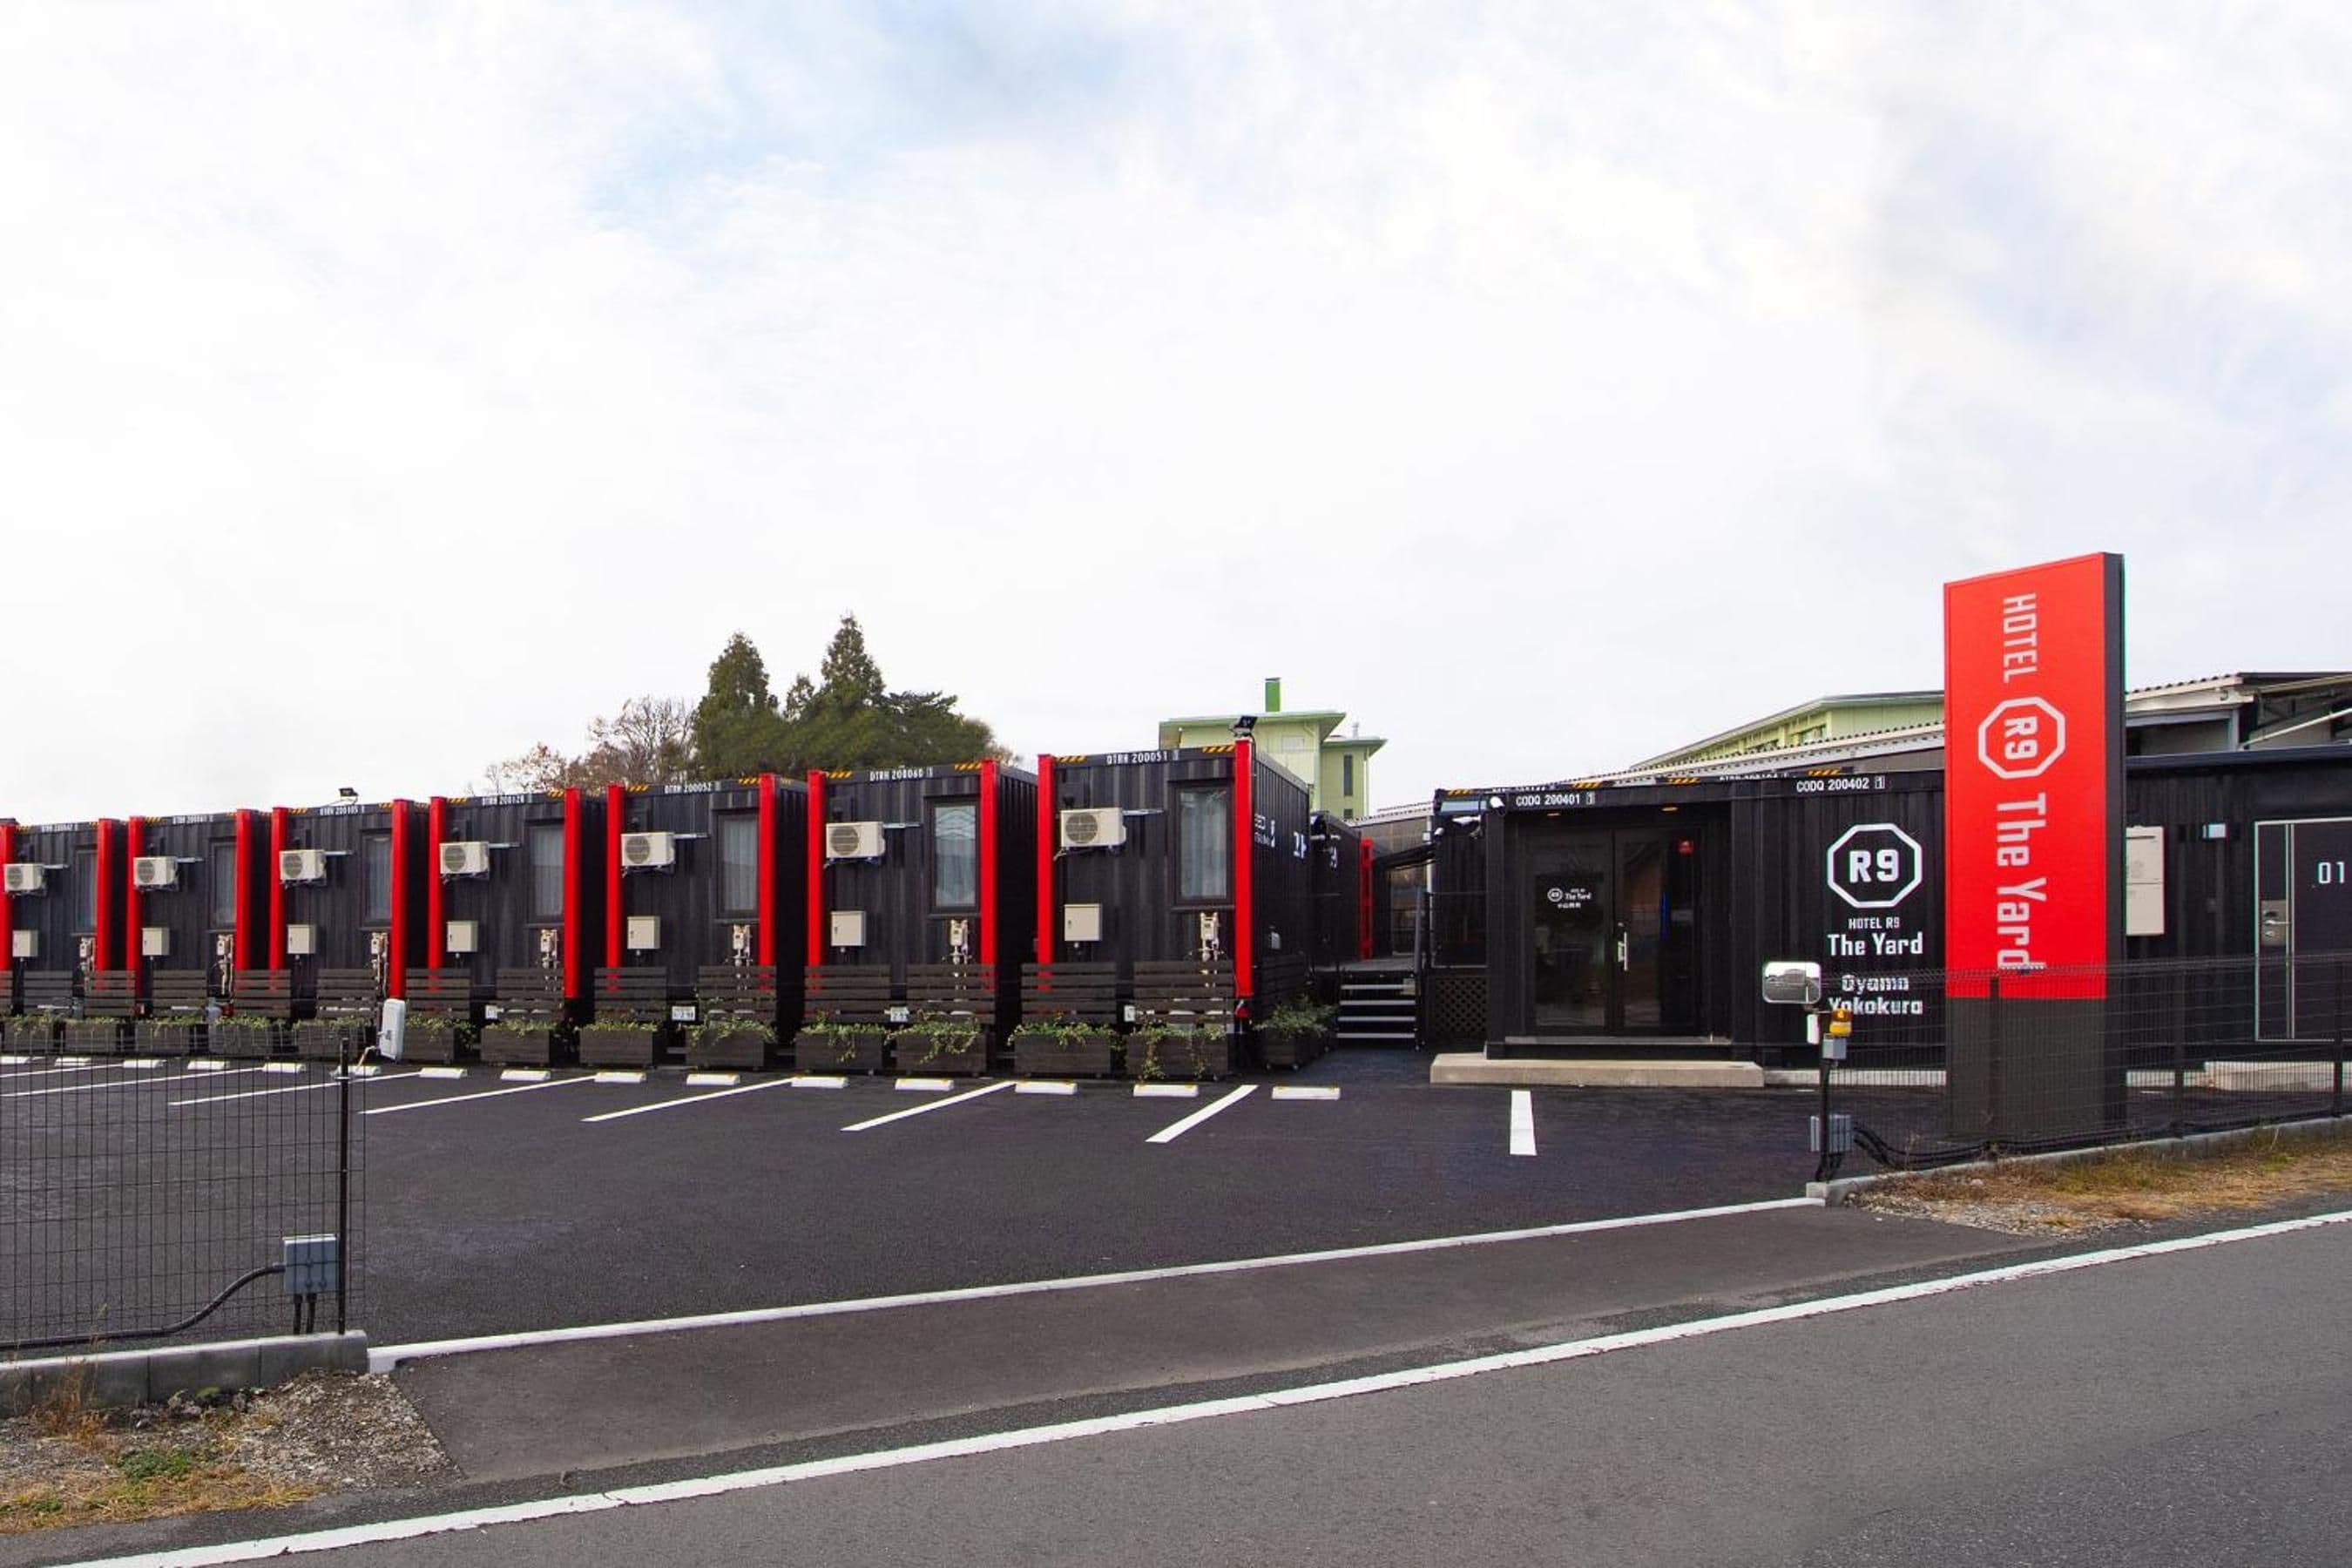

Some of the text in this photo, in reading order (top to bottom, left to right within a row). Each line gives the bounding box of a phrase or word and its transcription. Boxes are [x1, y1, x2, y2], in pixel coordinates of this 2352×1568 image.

[2003, 592, 2038, 684] HOTEL
[2004, 716, 2038, 760] R9
[1828, 777, 1869, 791] 200402
[1544, 791, 1580, 805] 200401
[1849, 848, 1899, 883] R9
[2318, 861, 2345, 884] 01
[1997, 792, 2047, 970] The Yard
[1848, 916, 1900, 929] HOTEL R9
[1828, 931, 1923, 956] The Yard
[1841, 974, 1909, 995] Oyama
[1828, 996, 1923, 1016] Yokokura
